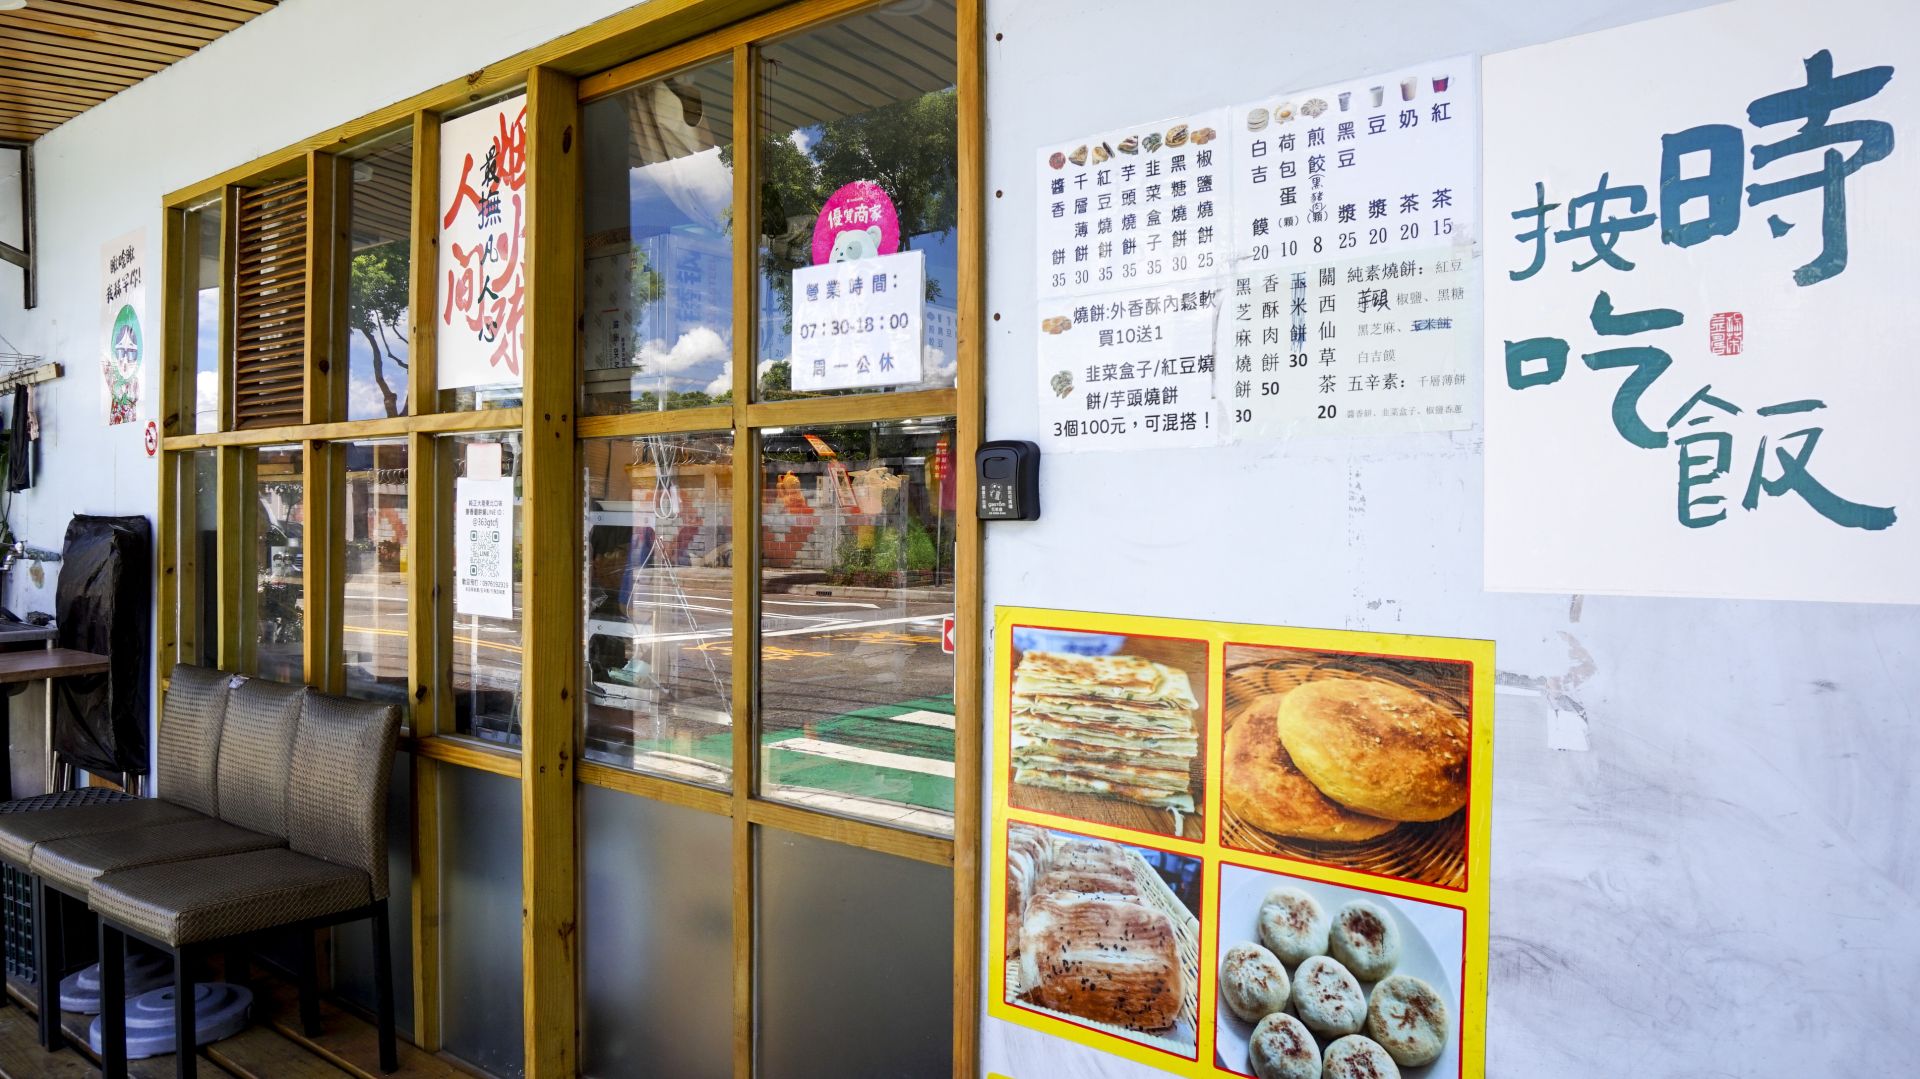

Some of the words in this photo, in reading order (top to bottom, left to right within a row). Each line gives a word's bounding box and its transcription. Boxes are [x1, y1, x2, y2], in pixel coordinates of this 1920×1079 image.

[1307, 126, 1326, 175] 煎餃
[1398, 109, 1419, 214] 奶茶
[1431, 102, 1452, 210] 紅茶
[1278, 133, 1297, 206] 荷包蛋
[1337, 121, 1356, 224] 黑豆漿
[1367, 114, 1387, 219] 豆漿
[1509, 48, 1895, 287] 按時
[1170, 154, 1188, 249] 黑糖燒餅
[1196, 149, 1214, 245] 椒鹽燒餅
[1251, 139, 1269, 237] 白吉饃
[1073, 172, 1089, 263] 千層薄餅
[1097, 169, 1113, 259] 紅豆燒餅
[1121, 163, 1138, 256] 芋頭燒餅
[1145, 160, 1162, 252] 韭菜盒子
[1051, 177, 1066, 266] 醬香餅
[1400, 222, 1420, 241] 20
[1433, 217, 1453, 237] 15
[478, 144, 502, 343] 最撫凡人心
[1281, 240, 1298, 258] 10
[1313, 236, 1323, 253] 8
[1338, 232, 1357, 249] 25
[1368, 227, 1388, 245] 20
[1172, 255, 1188, 272] 30
[1197, 252, 1214, 269] 25
[1252, 245, 1269, 261] 20
[1052, 272, 1067, 288] 35
[1074, 269, 1090, 285] 30
[1098, 266, 1114, 282] 35
[1122, 262, 1138, 278] 35
[1146, 259, 1163, 275] 35
[1098, 325, 1164, 347] 買10送1
[1261, 274, 1280, 372] 香酥肉餅
[1318, 267, 1337, 394] 關西仙草茶
[1235, 277, 1252, 399] 黑芝麻燒餅
[812, 351, 895, 378] 周一公休
[1085, 354, 1216, 383] 韭菜盒子/紅豆燒
[1289, 353, 1308, 368] 30
[1357, 348, 1396, 364] 白吉饃
[1085, 386, 1179, 411] 餅/芋頭燒餅
[1261, 381, 1280, 396] 50
[1235, 408, 1252, 423] 30
[1317, 404, 1337, 419] 20
[1503, 289, 1897, 530] 吃飯
